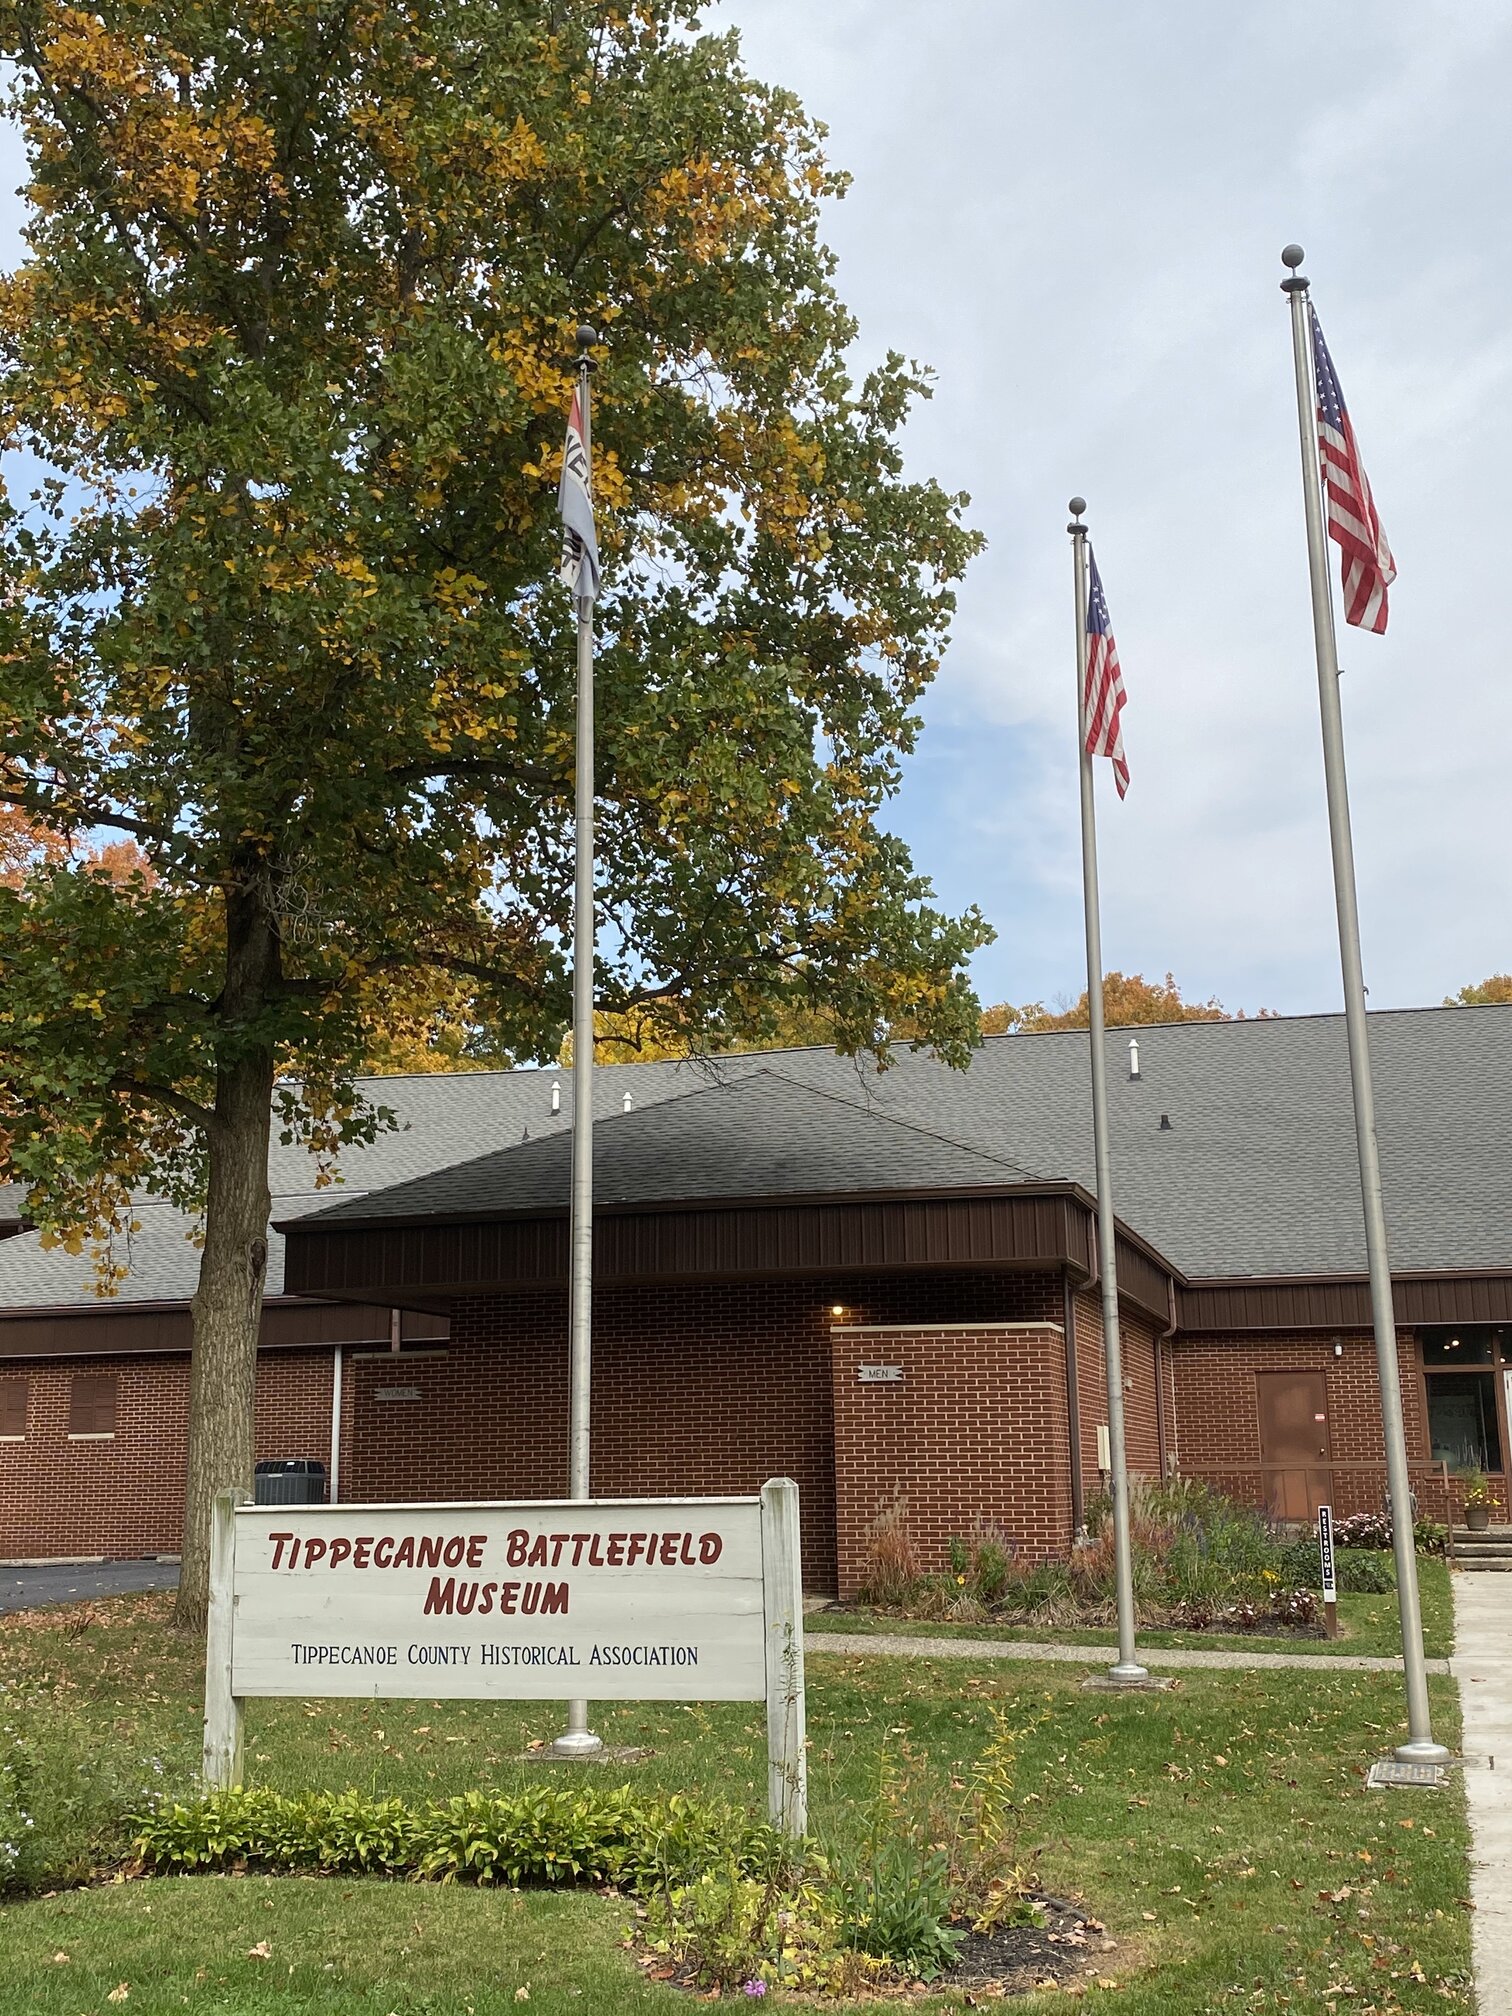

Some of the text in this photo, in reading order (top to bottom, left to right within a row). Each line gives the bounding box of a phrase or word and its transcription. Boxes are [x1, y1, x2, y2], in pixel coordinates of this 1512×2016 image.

[868, 1369, 888, 1378] MEN
[383, 1388, 414, 1397] WOMEN
[268, 1528, 723, 1570] TIPPECANOE BATTLEFIELD
[1321, 1510, 1331, 1576] RESTROOMS
[423, 1576, 570, 1616] MUSEUM
[290, 1643, 698, 1666] TIPPECANOE COUNTY HISTORICAL ASSOCIATION
